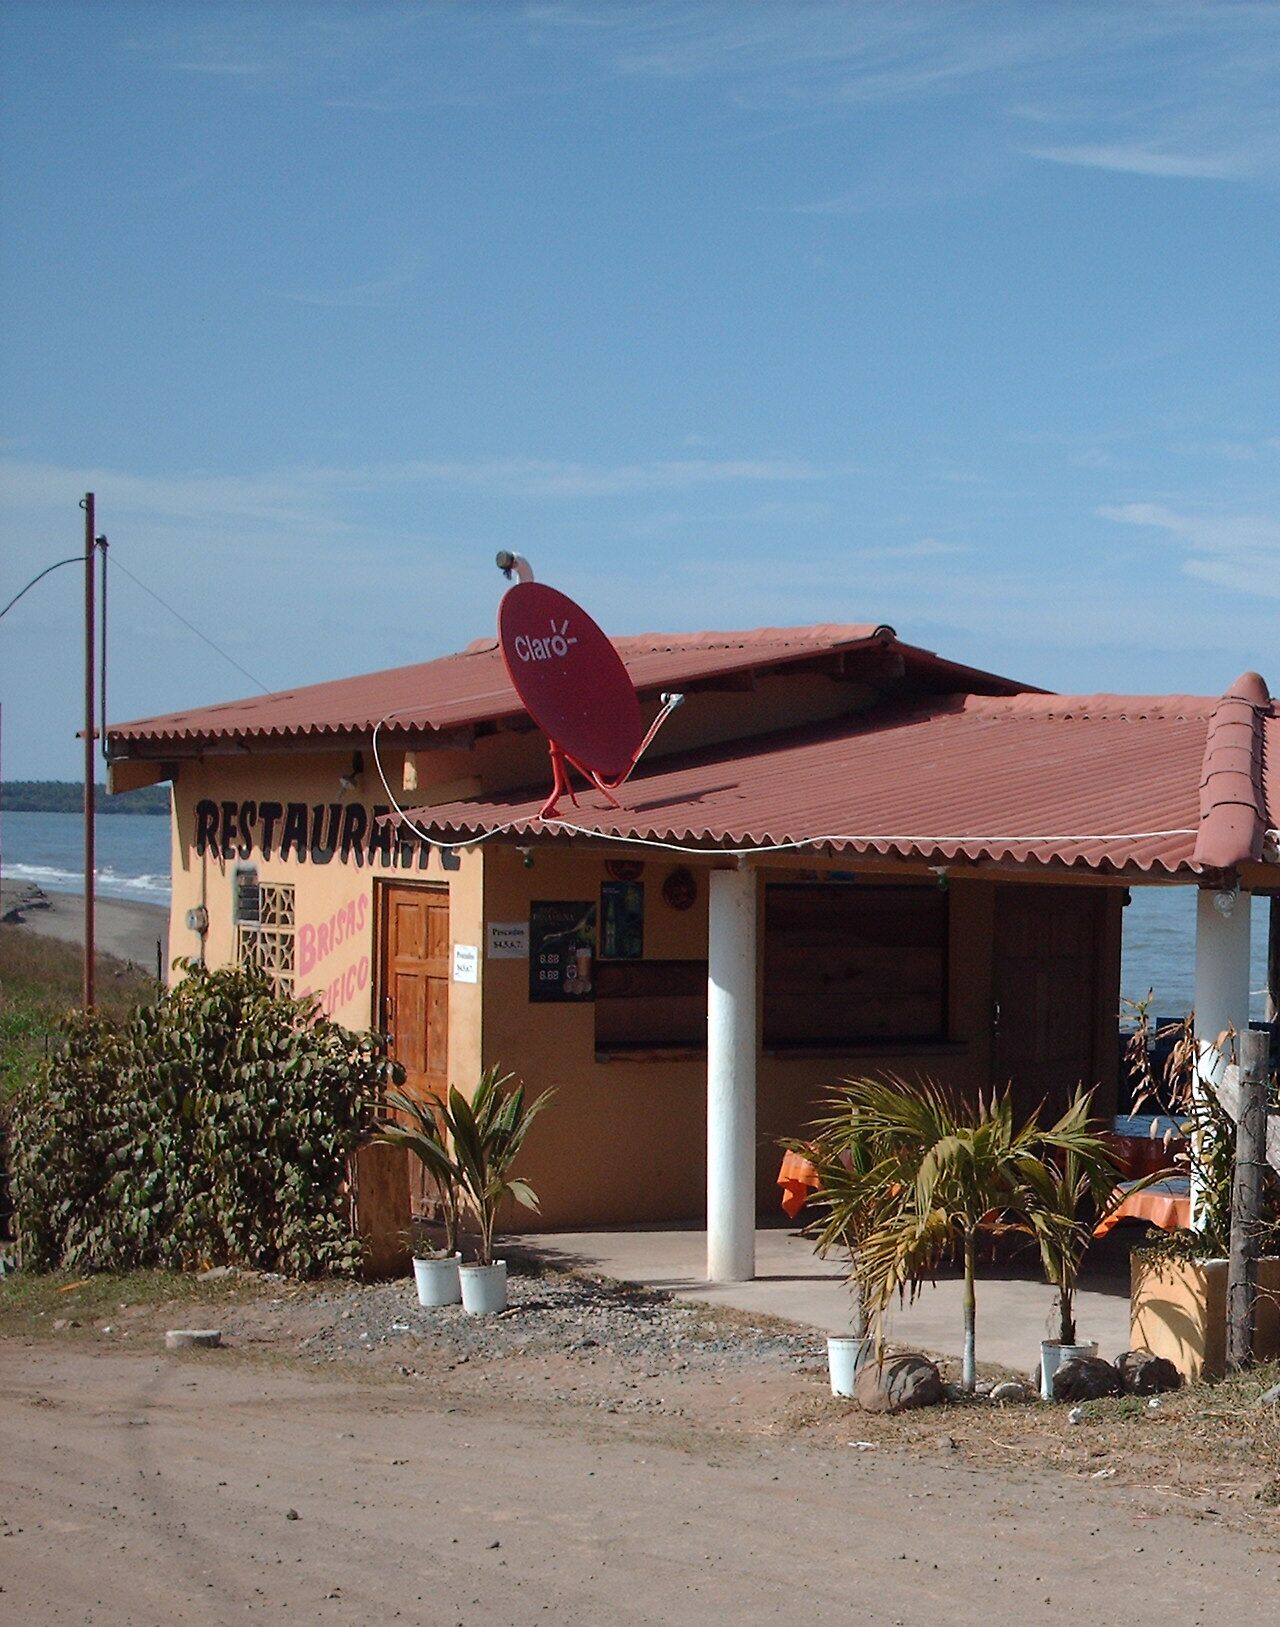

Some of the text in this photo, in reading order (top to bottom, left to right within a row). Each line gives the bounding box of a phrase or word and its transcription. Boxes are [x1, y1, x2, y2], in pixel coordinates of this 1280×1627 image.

[515, 625, 574, 662] Claro
[298, 893, 368, 977] BRISAS
[298, 956, 369, 1018] IFICO
